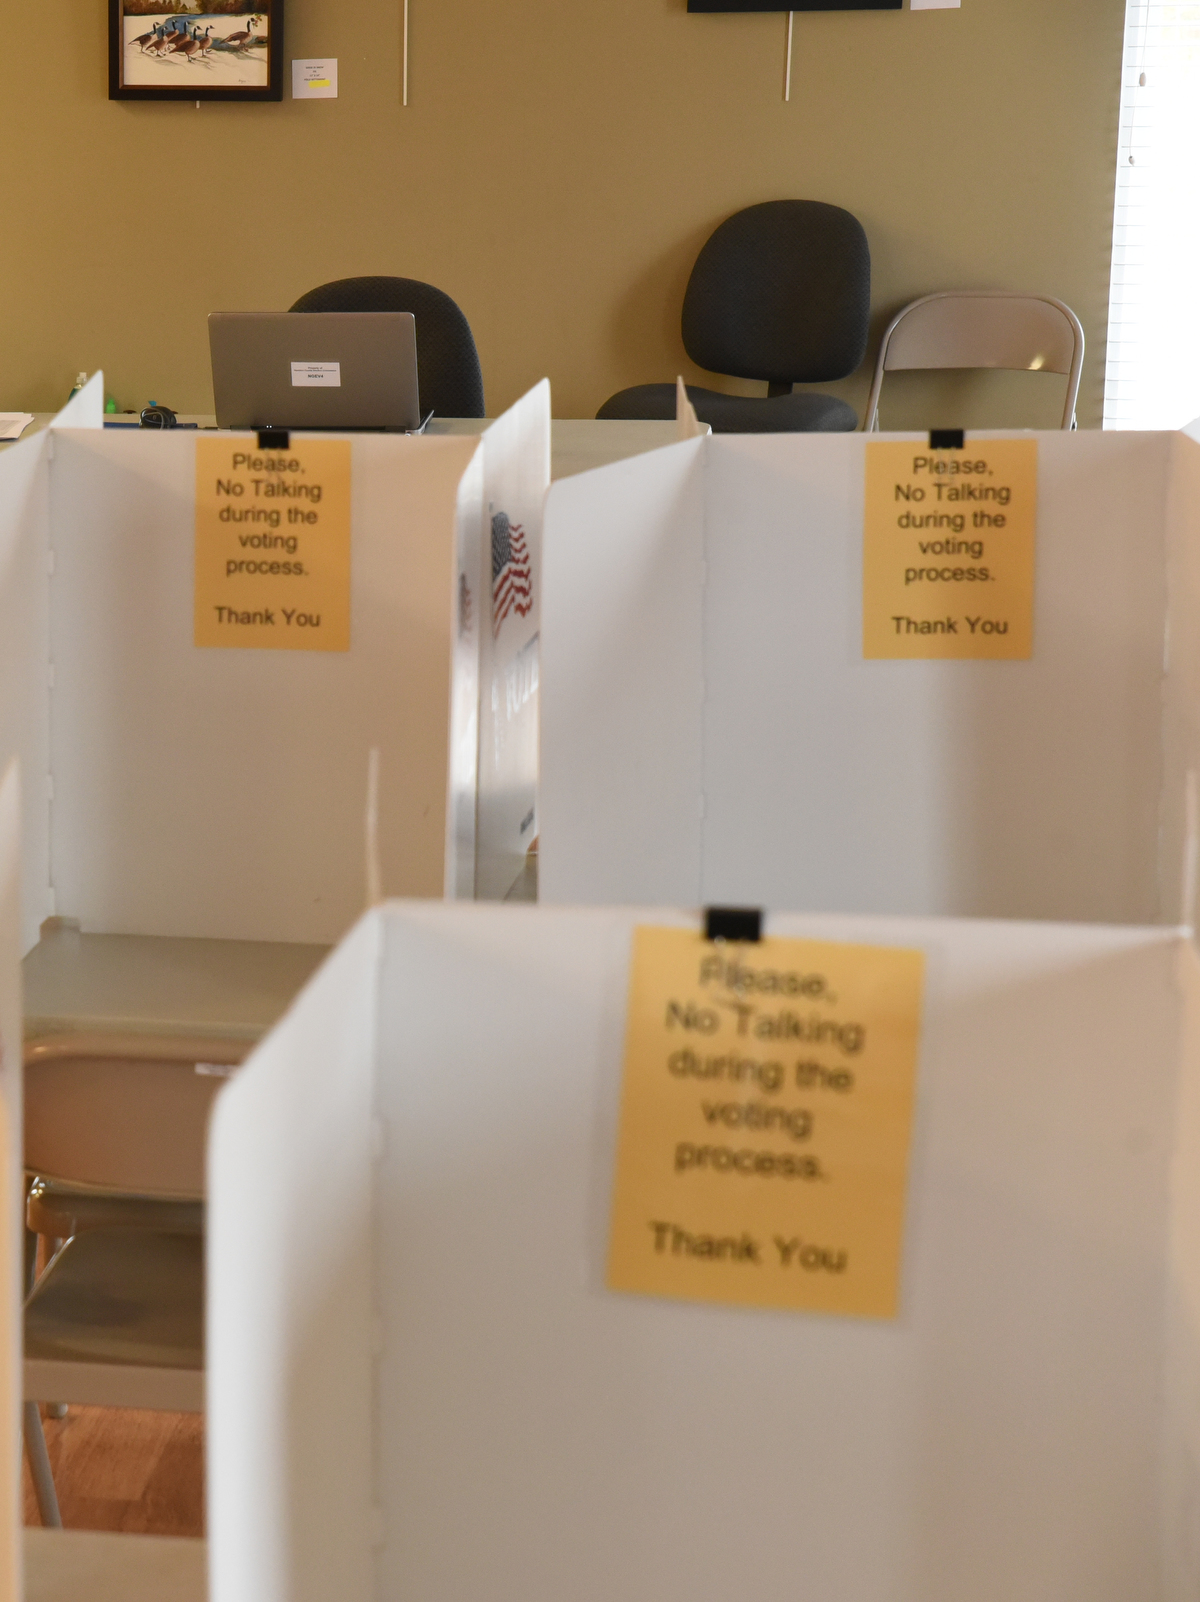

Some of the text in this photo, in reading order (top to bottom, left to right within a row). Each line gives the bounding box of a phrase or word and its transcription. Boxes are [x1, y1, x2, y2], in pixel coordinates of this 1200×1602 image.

[233, 453, 305, 474] Please,
[913, 457, 993, 476] Please,
[216, 479, 322, 503] No Talking
[895, 483, 1011, 505] No Talking
[219, 505, 318, 527] during the
[898, 511, 1006, 532] during the
[239, 533, 297, 554] voting
[919, 537, 983, 558] voting
[226, 560, 309, 577] process.
[905, 567, 995, 586] process.
[214, 606, 321, 627] Thank You
[892, 616, 1008, 634] Thank You
[665, 1001, 866, 1055] No Talking
[668, 1049, 854, 1095] during the
[702, 1099, 813, 1142] voting
[675, 1142, 830, 1182] process.
[649, 1220, 847, 1274] Thank You
